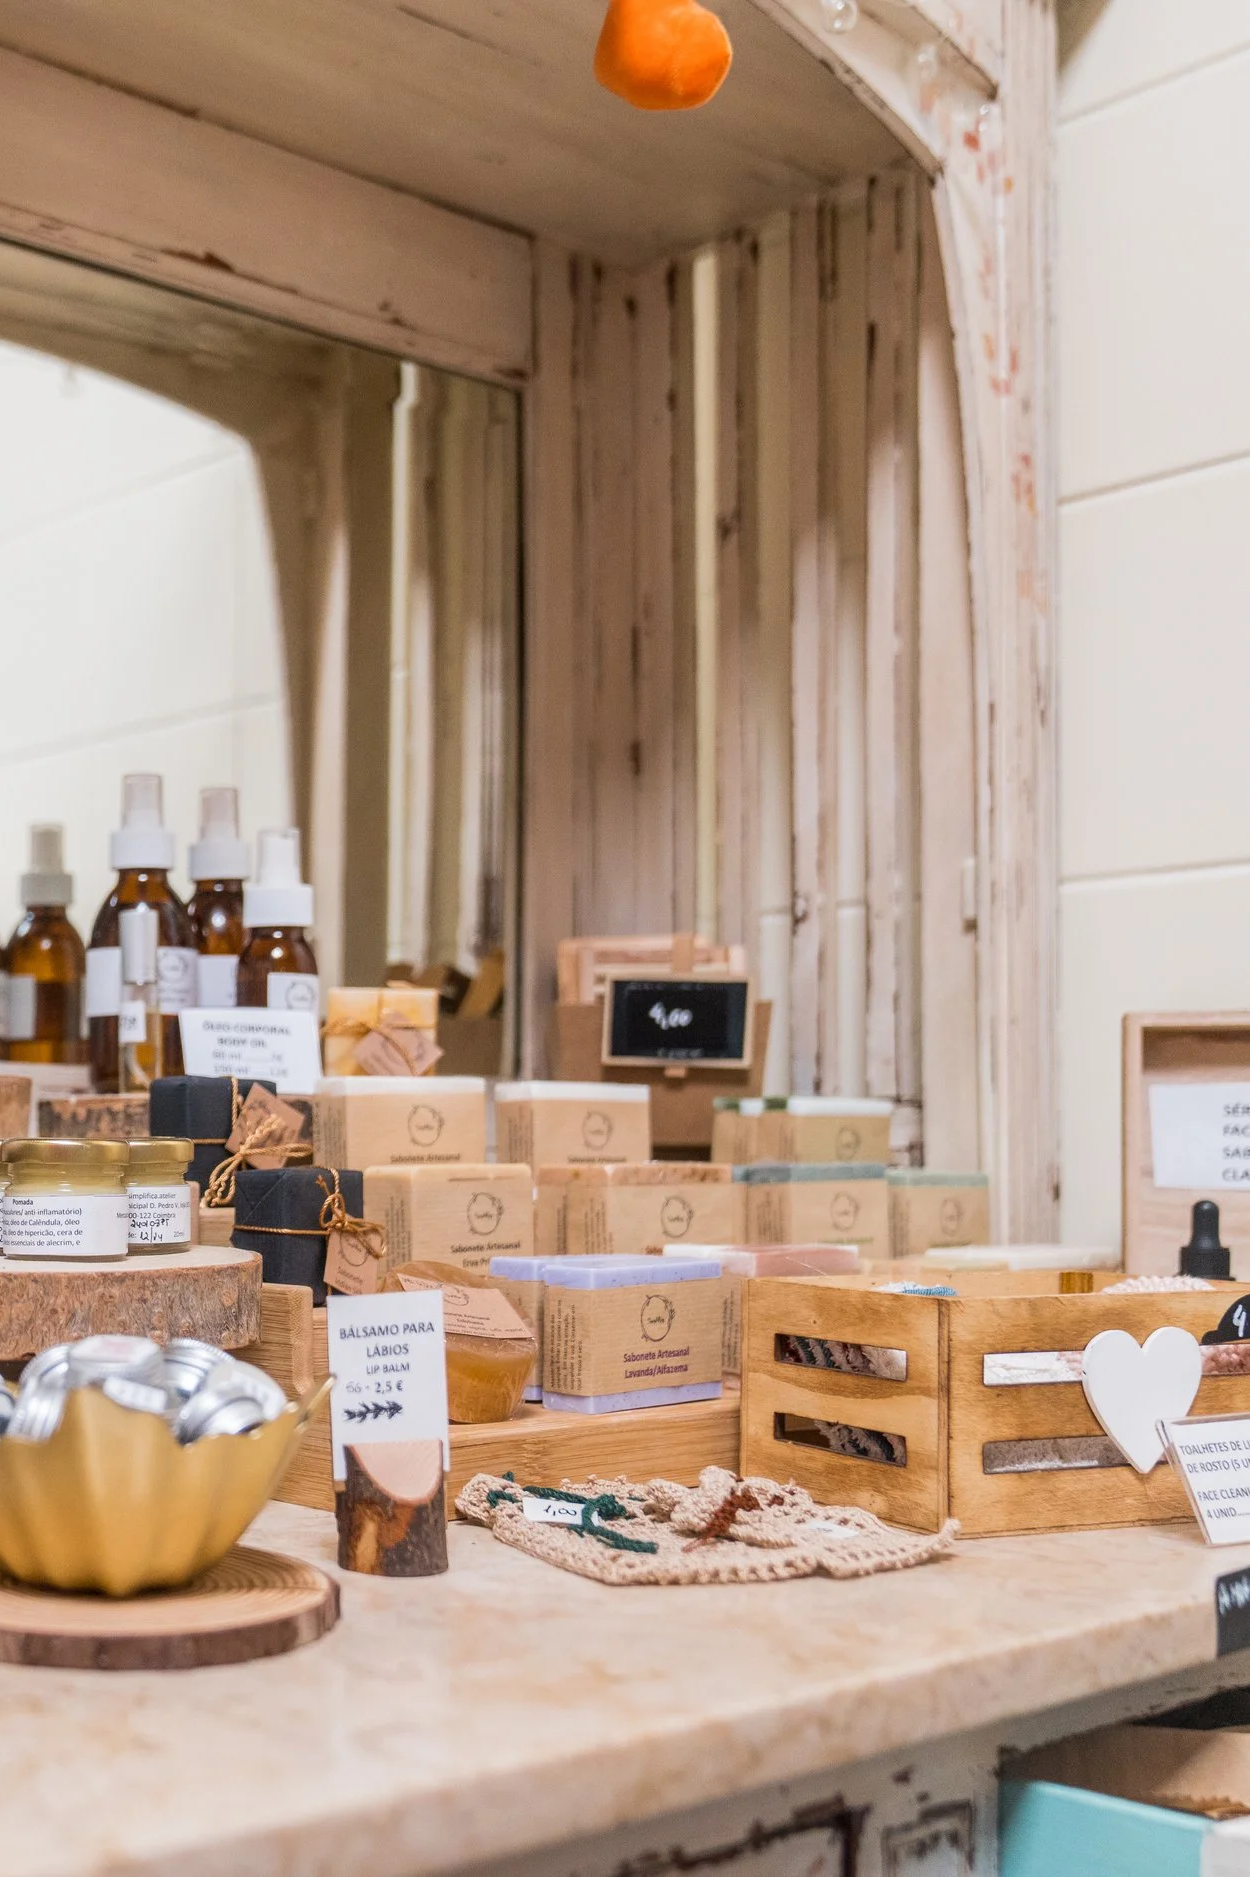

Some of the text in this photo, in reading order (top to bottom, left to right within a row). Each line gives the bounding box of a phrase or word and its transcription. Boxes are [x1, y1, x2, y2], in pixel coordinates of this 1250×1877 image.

[12, 1198, 34, 1206] Pomada
[29, 1219, 63, 1227] Calêndula,
[64, 1218, 81, 1226] óleo
[339, 1323, 399, 1339] BÁLSAMO
[402, 1321, 435, 1334] PARA
[366, 1343, 410, 1358] LÁBIOS
[623, 1346, 690, 1363] Sabonete Artesanal
[366, 1362, 410, 1375] LIP BALM
[625, 1363, 689, 1379] Lavanda/Alfazema
[374, 1382, 392, 1394] 2,5
[396, 1380, 403, 1391] €
[1179, 1441, 1229, 1455] TOALHETES
[1229, 1440, 1242, 1451] DE
[1186, 1463, 1199, 1473] DE
[1199, 1460, 1230, 1472] ROSTO
[1197, 1490, 1220, 1501] FACE
